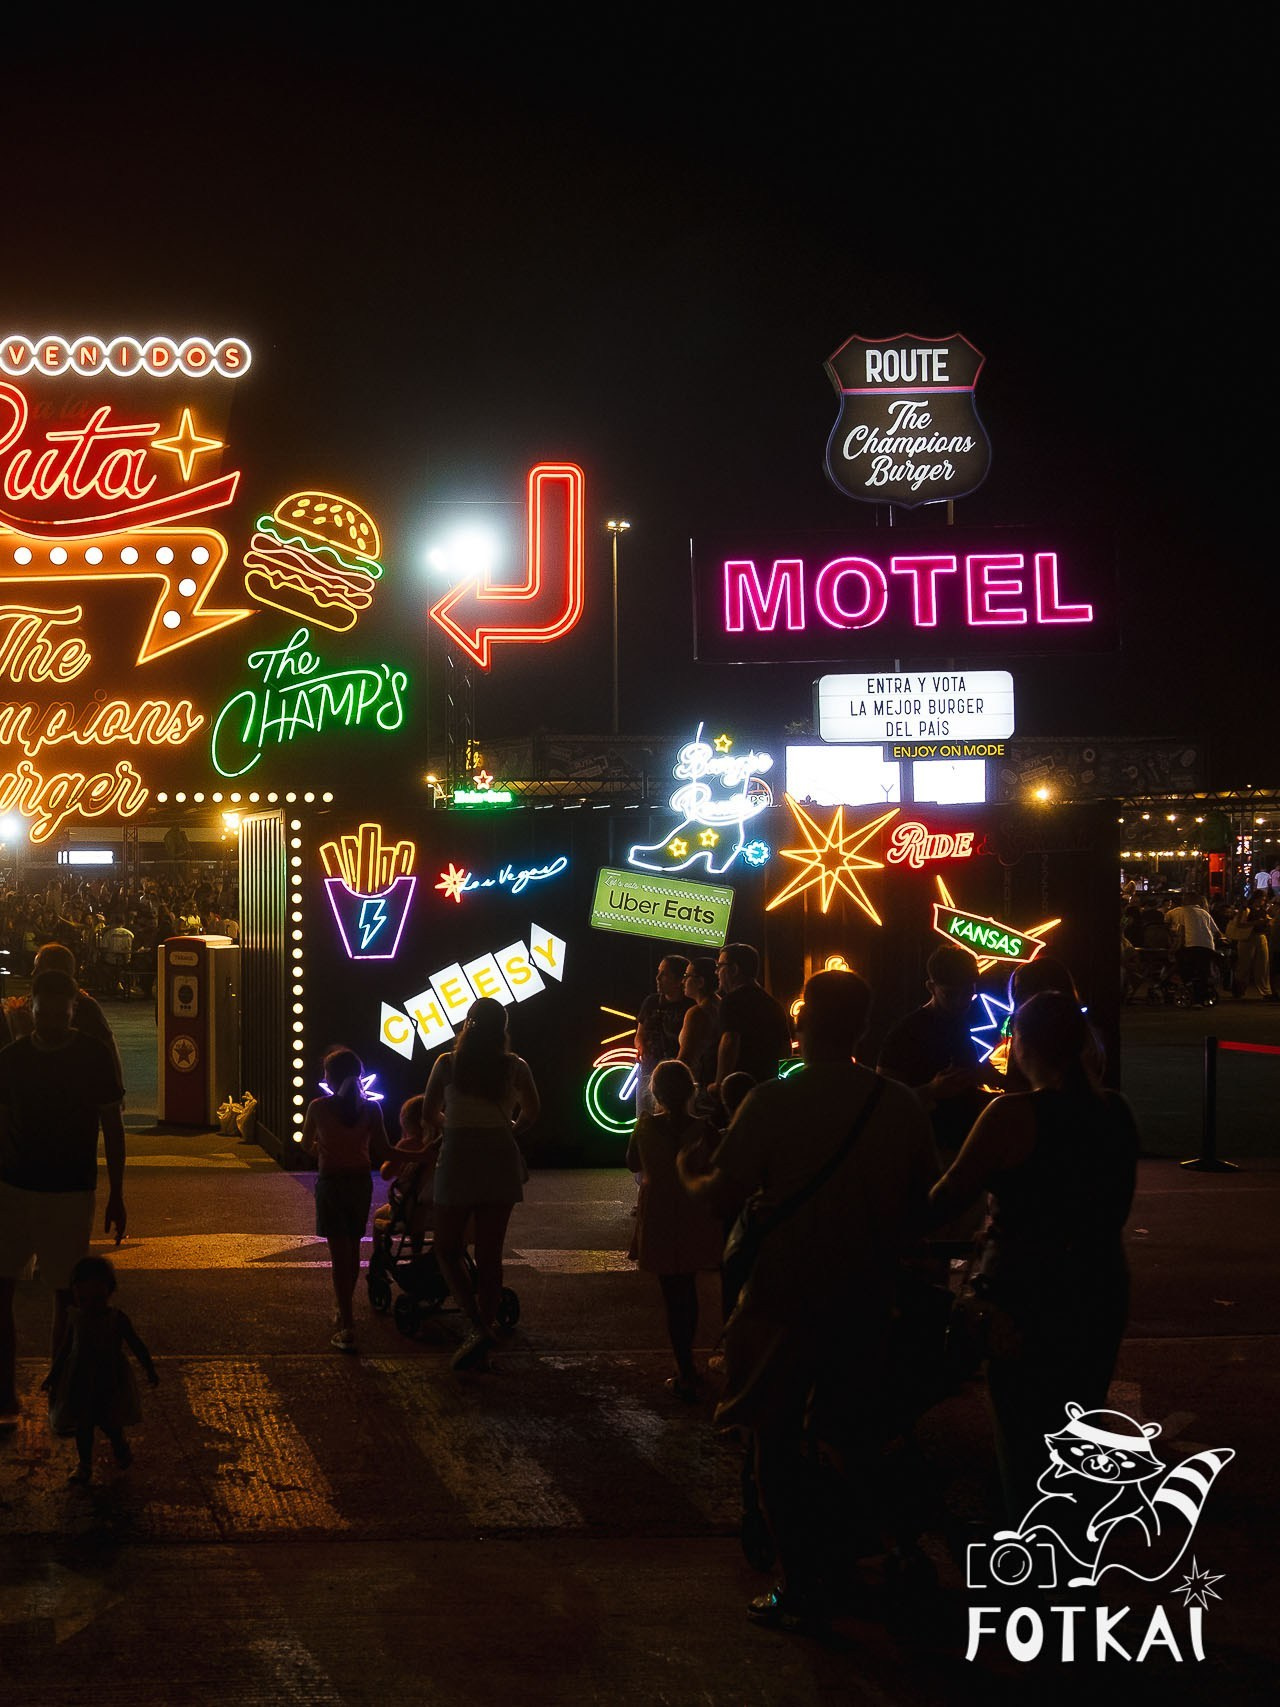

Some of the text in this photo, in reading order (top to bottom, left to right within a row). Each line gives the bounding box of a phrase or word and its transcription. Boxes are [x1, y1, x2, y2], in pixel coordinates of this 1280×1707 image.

[865, 348, 950, 383] ROUTE
[886, 400, 932, 436] The
[842, 425, 976, 460] Champions
[864, 455, 956, 491] Burger
[724, 553, 1093, 632] MOTEL
[247, 627, 320, 684] The
[866, 676, 967, 695] ENTRA Y VOTA
[849, 698, 984, 717] LA MEJOR BURGER
[885, 718, 950, 737] DEL PAÍS
[893, 744, 1005, 758] ENJOY ON MODE
[886, 821, 974, 869] RIDE
[499, 857, 568, 894] Vegas
[609, 889, 715, 925] Uber Eats
[948, 915, 1023, 958] KANSAS
[383, 938, 557, 1044] CHEESY
